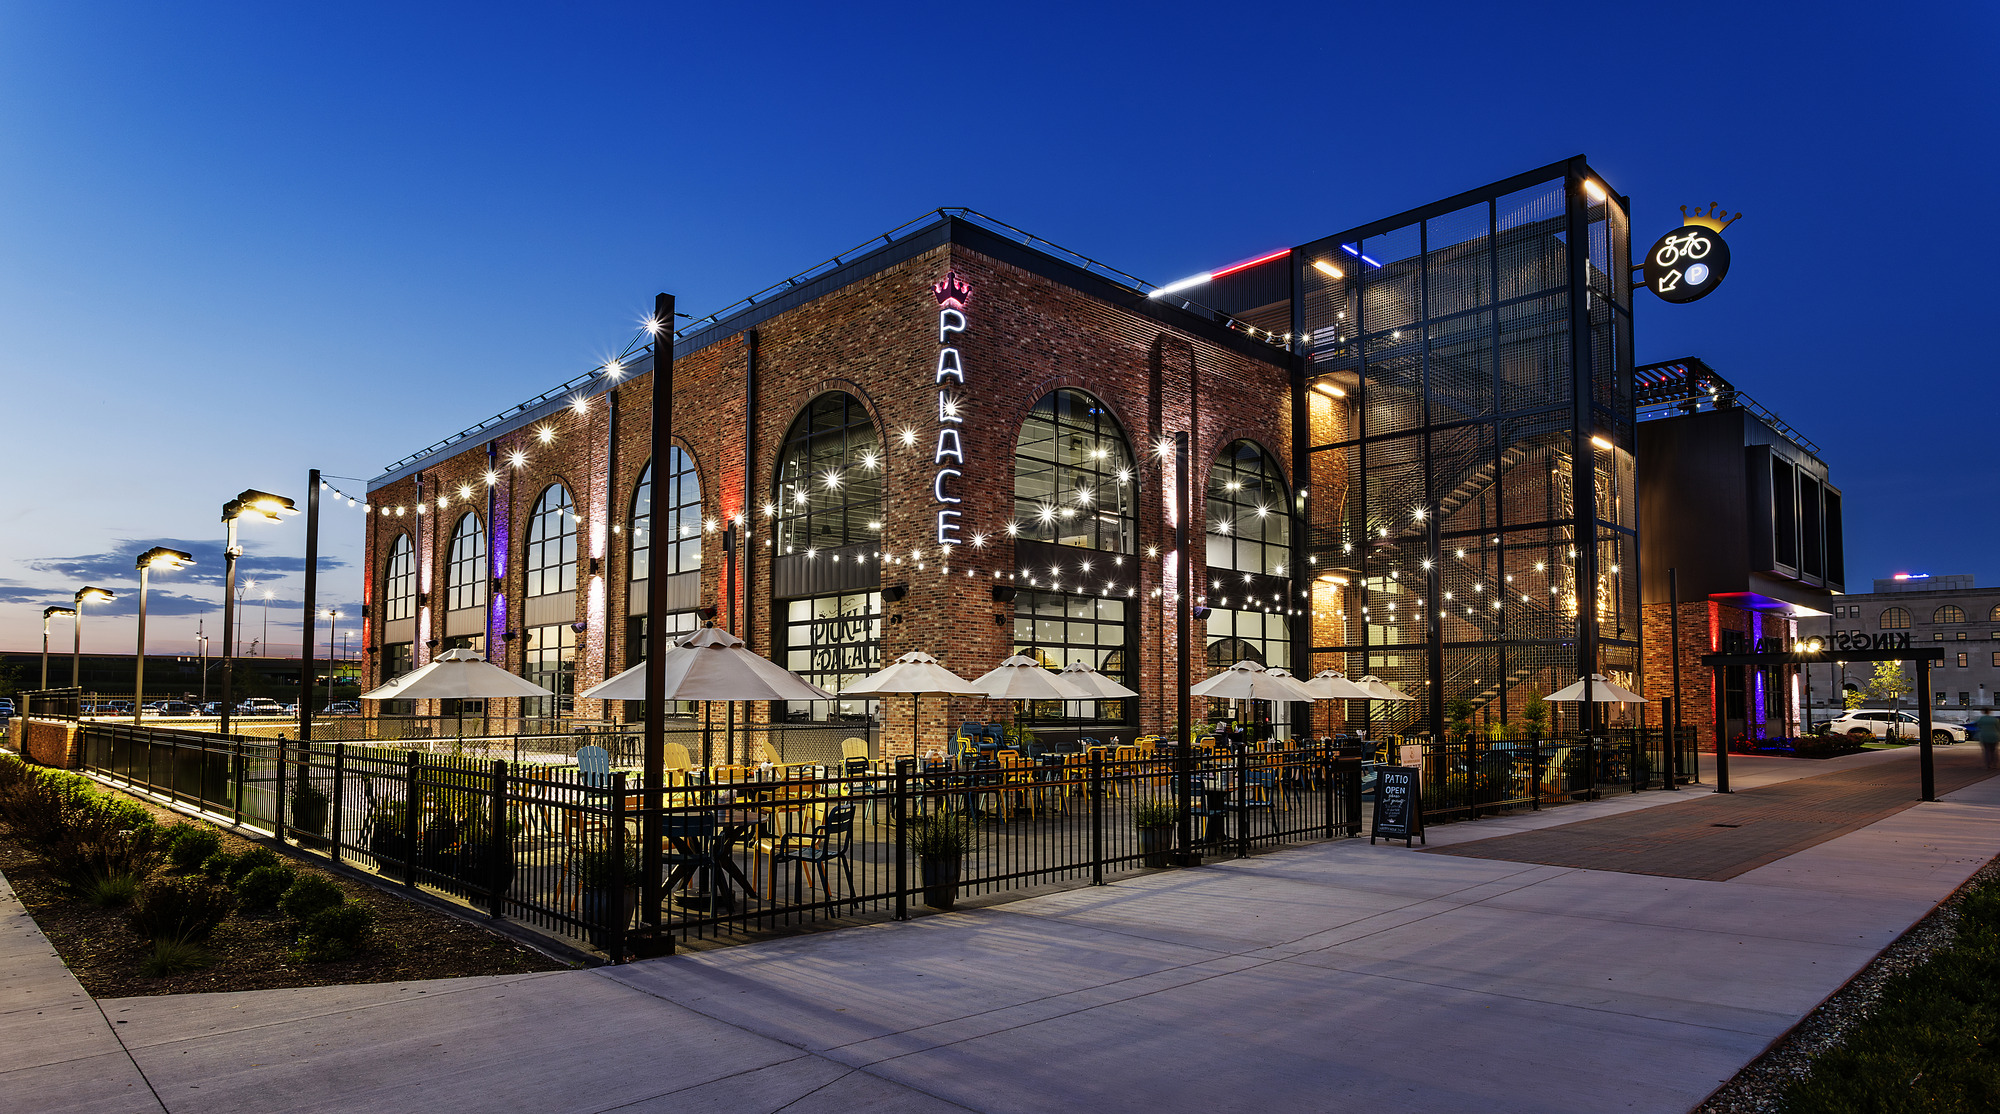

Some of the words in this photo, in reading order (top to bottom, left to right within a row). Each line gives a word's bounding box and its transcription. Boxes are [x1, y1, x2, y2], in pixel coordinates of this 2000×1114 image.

[1691, 266, 1702, 282] P
[935, 308, 967, 544] PALACE
[810, 605, 873, 645] PICKLE
[1384, 773, 1409, 784] PATIO
[1385, 786, 1406, 794] OPEN
